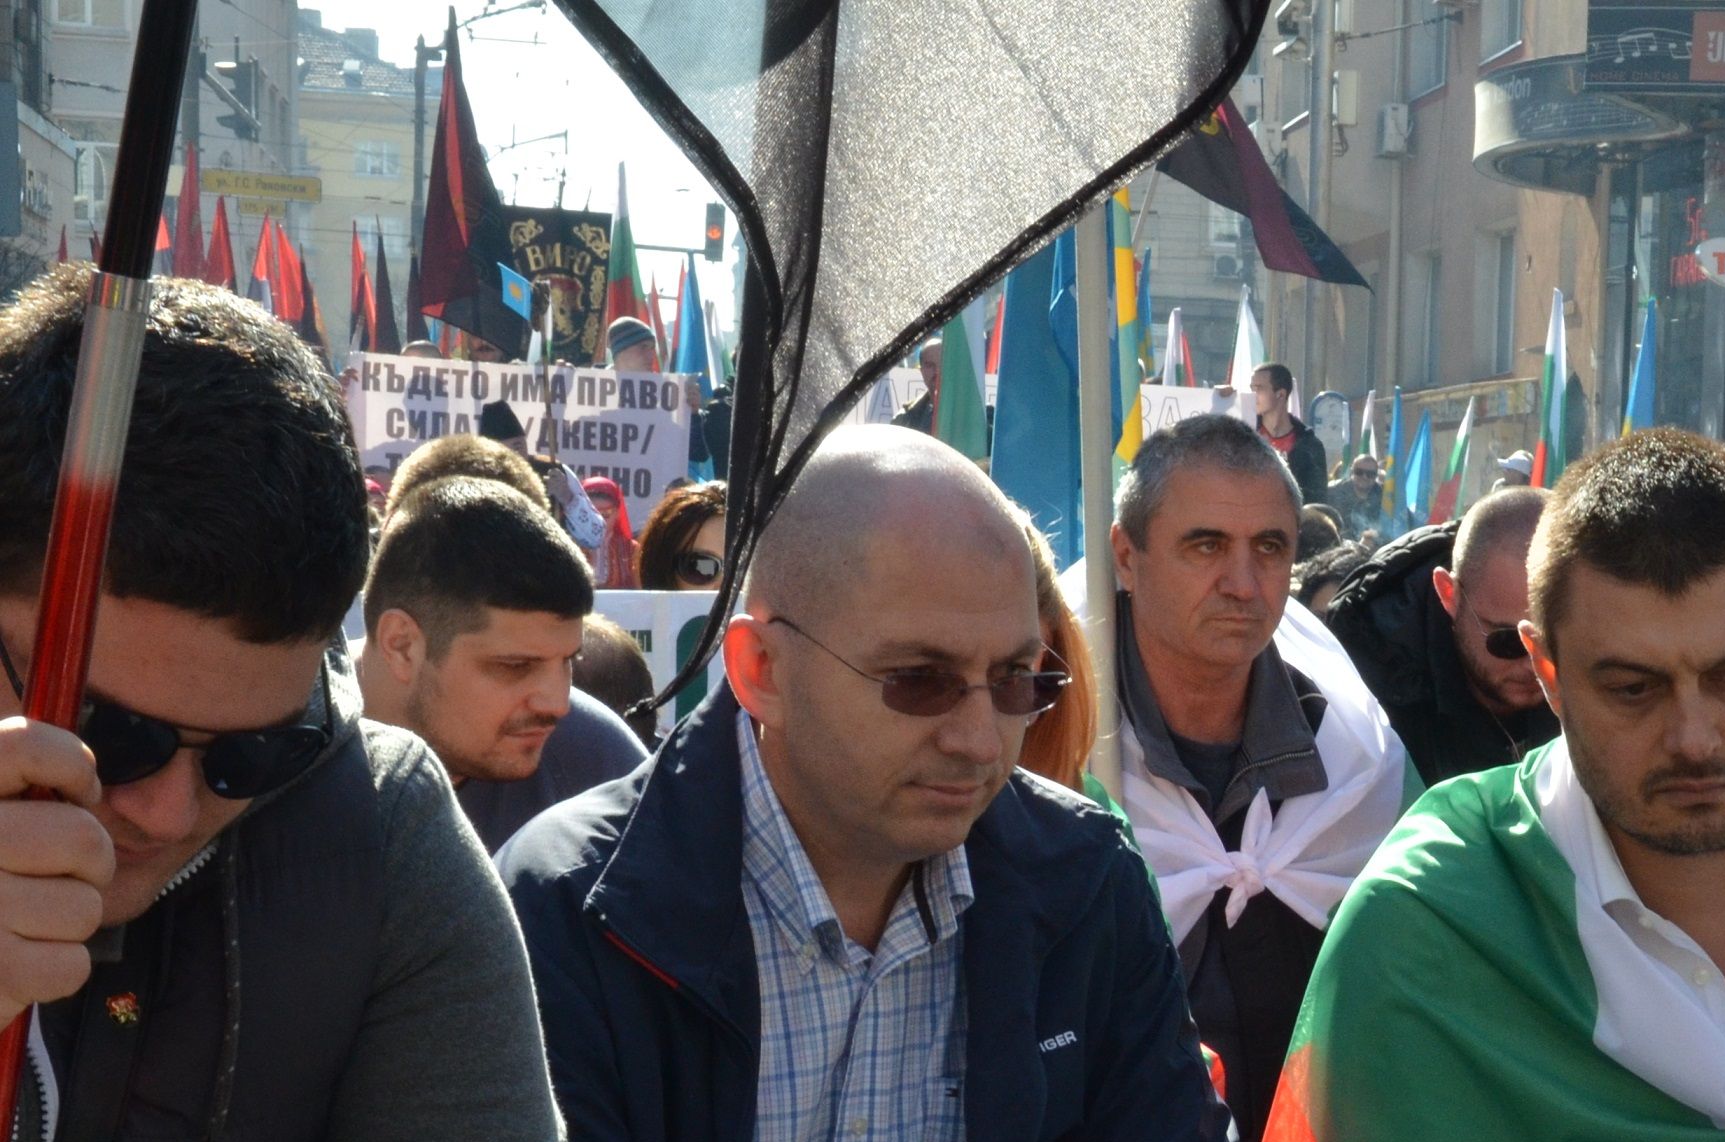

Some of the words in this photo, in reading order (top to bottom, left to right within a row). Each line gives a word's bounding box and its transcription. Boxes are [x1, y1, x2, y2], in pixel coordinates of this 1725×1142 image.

[361, 361, 490, 401] КЪДЕТО
[499, 372, 567, 405] ИМА
[576, 377, 680, 413] ПРАВО
[1039, 1030, 1077, 1053] IGER
